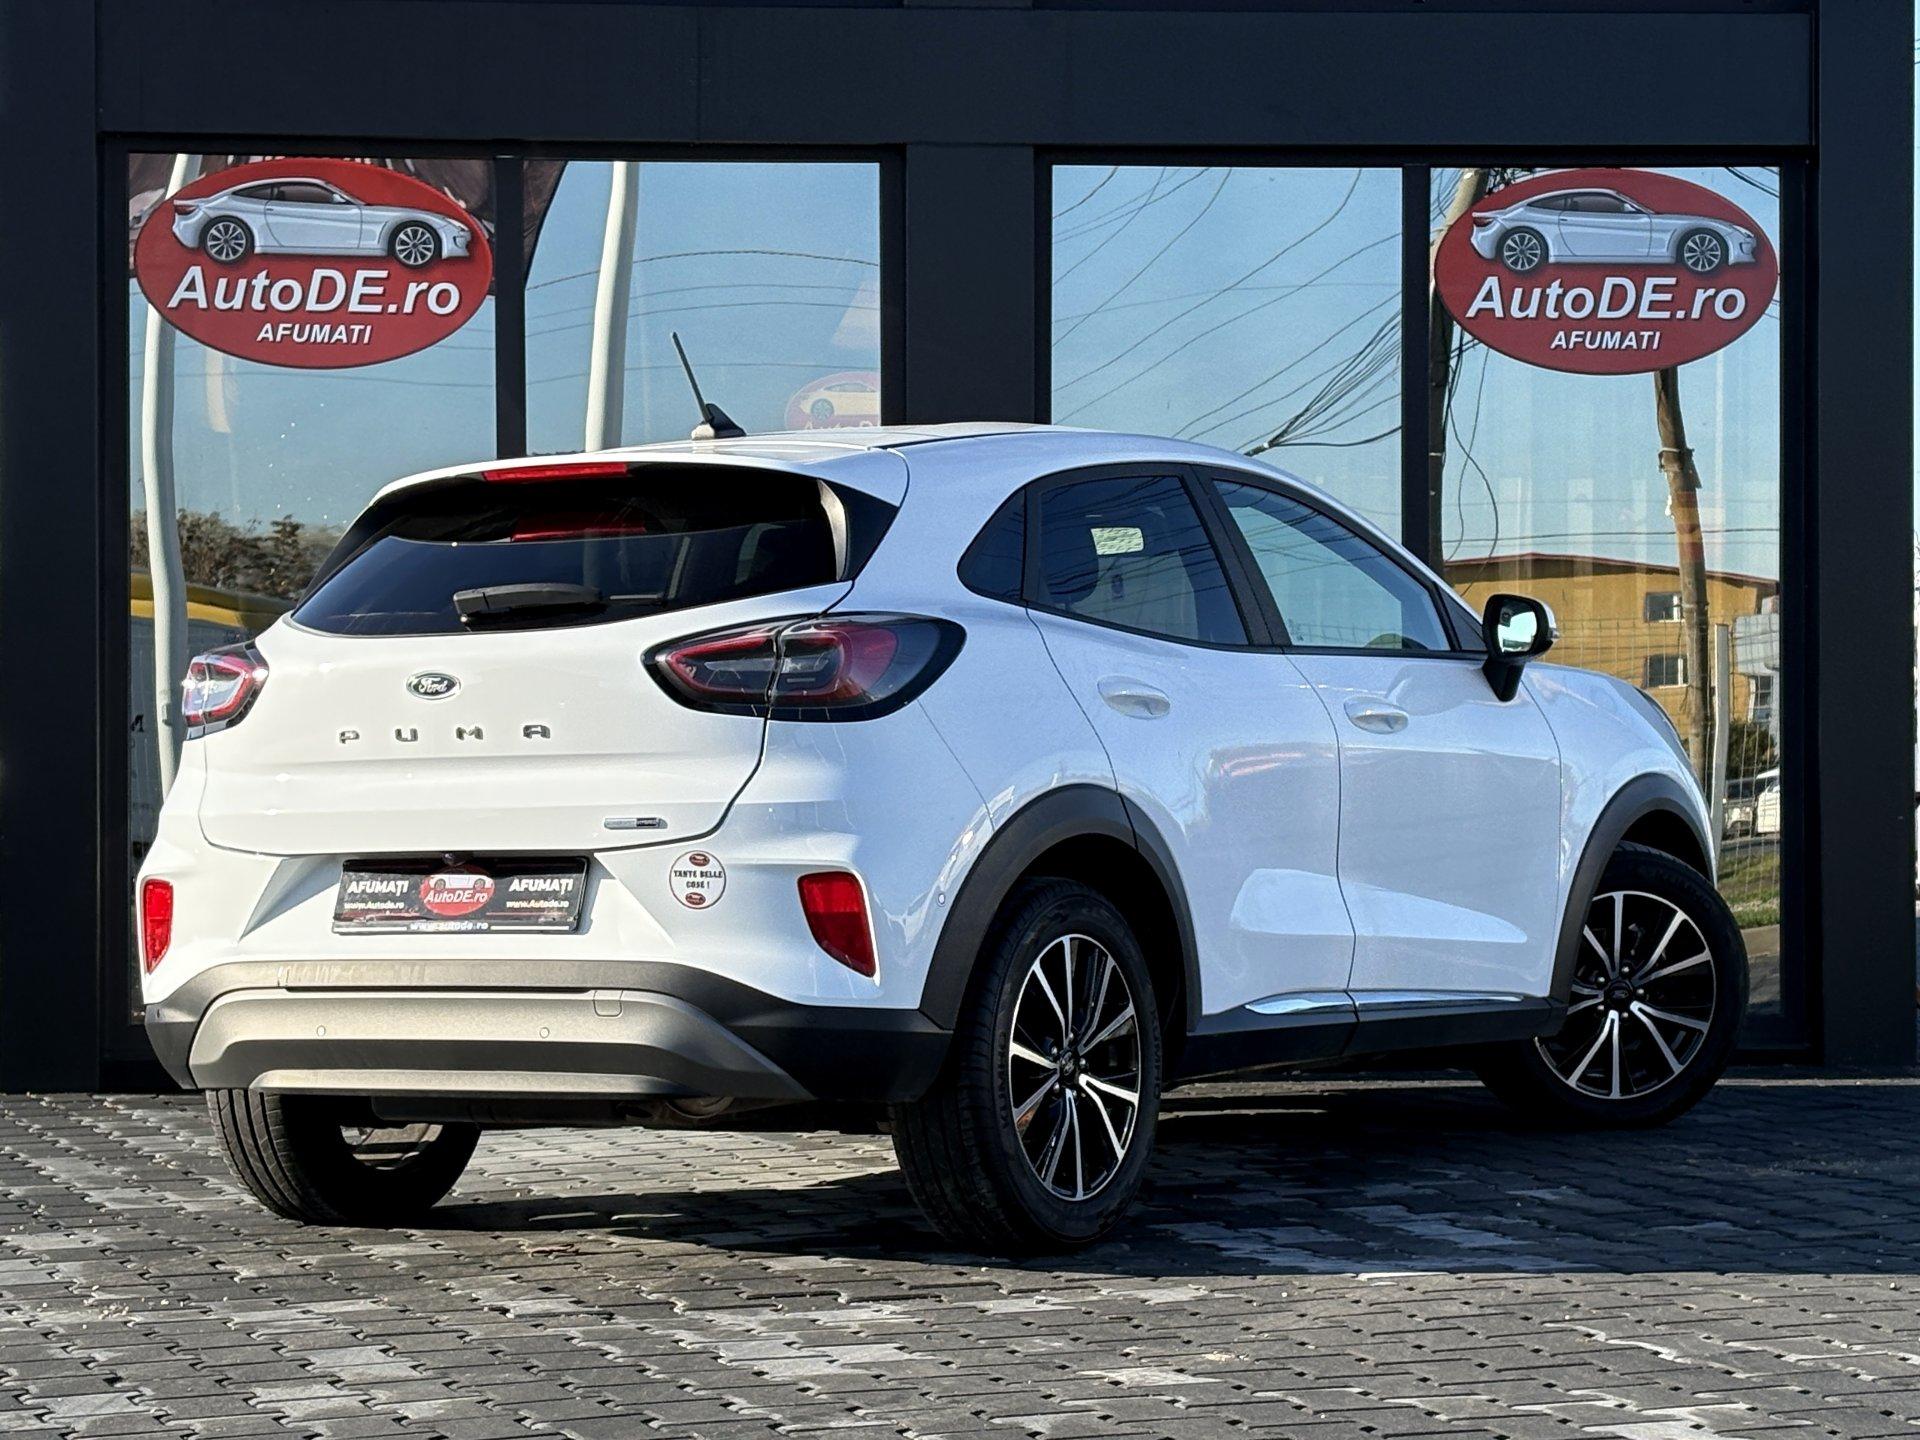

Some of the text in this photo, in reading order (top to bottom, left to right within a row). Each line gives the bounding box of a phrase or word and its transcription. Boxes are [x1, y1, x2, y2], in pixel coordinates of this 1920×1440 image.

[168, 266, 461, 316] AutoDE.ro
[1465, 276, 1747, 320] AutoDE.ro
[256, 322, 372, 344] AFUMATI
[1550, 331, 1661, 350] AFUMATI
[418, 677, 448, 693] Ford
[340, 724, 551, 744] PUMA
